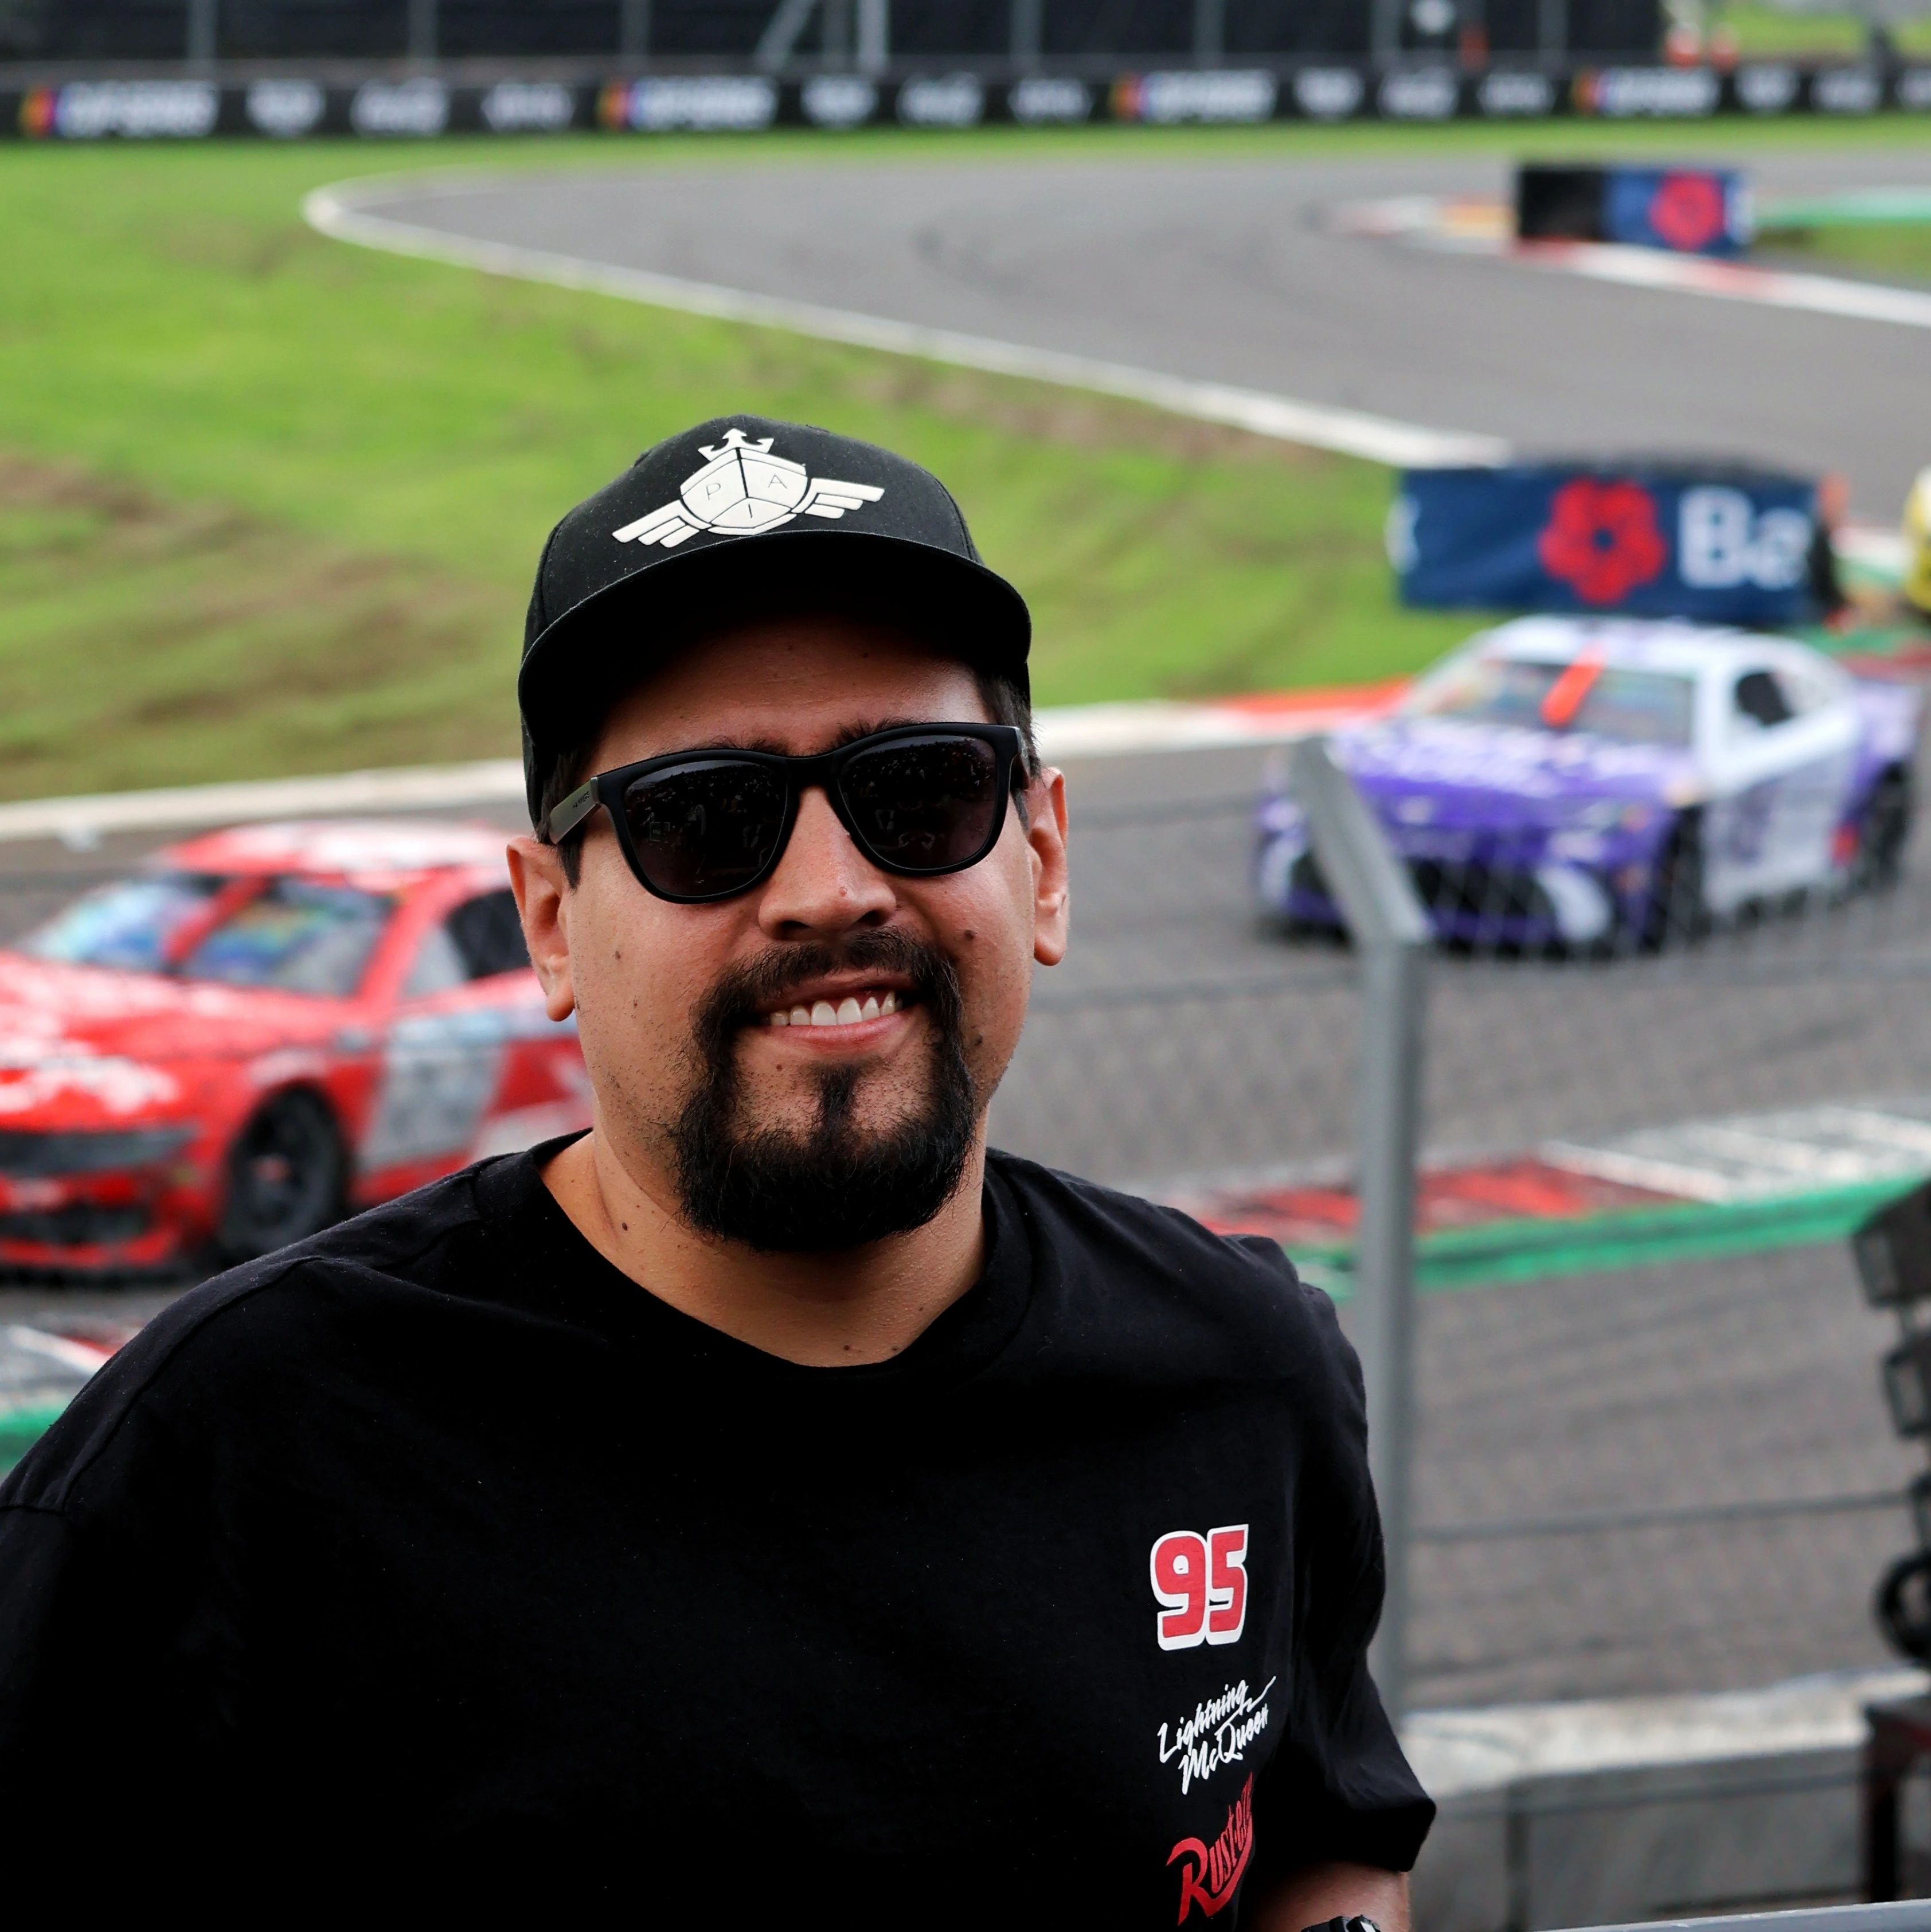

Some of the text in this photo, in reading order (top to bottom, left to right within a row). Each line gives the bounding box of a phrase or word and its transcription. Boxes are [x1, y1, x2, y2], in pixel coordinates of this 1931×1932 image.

[706, 474, 788, 501] P A
[1150, 1524, 1249, 1651] 95
[1157, 1676, 1276, 1763] Lightning
[1178, 1702, 1269, 1795] McQueen
